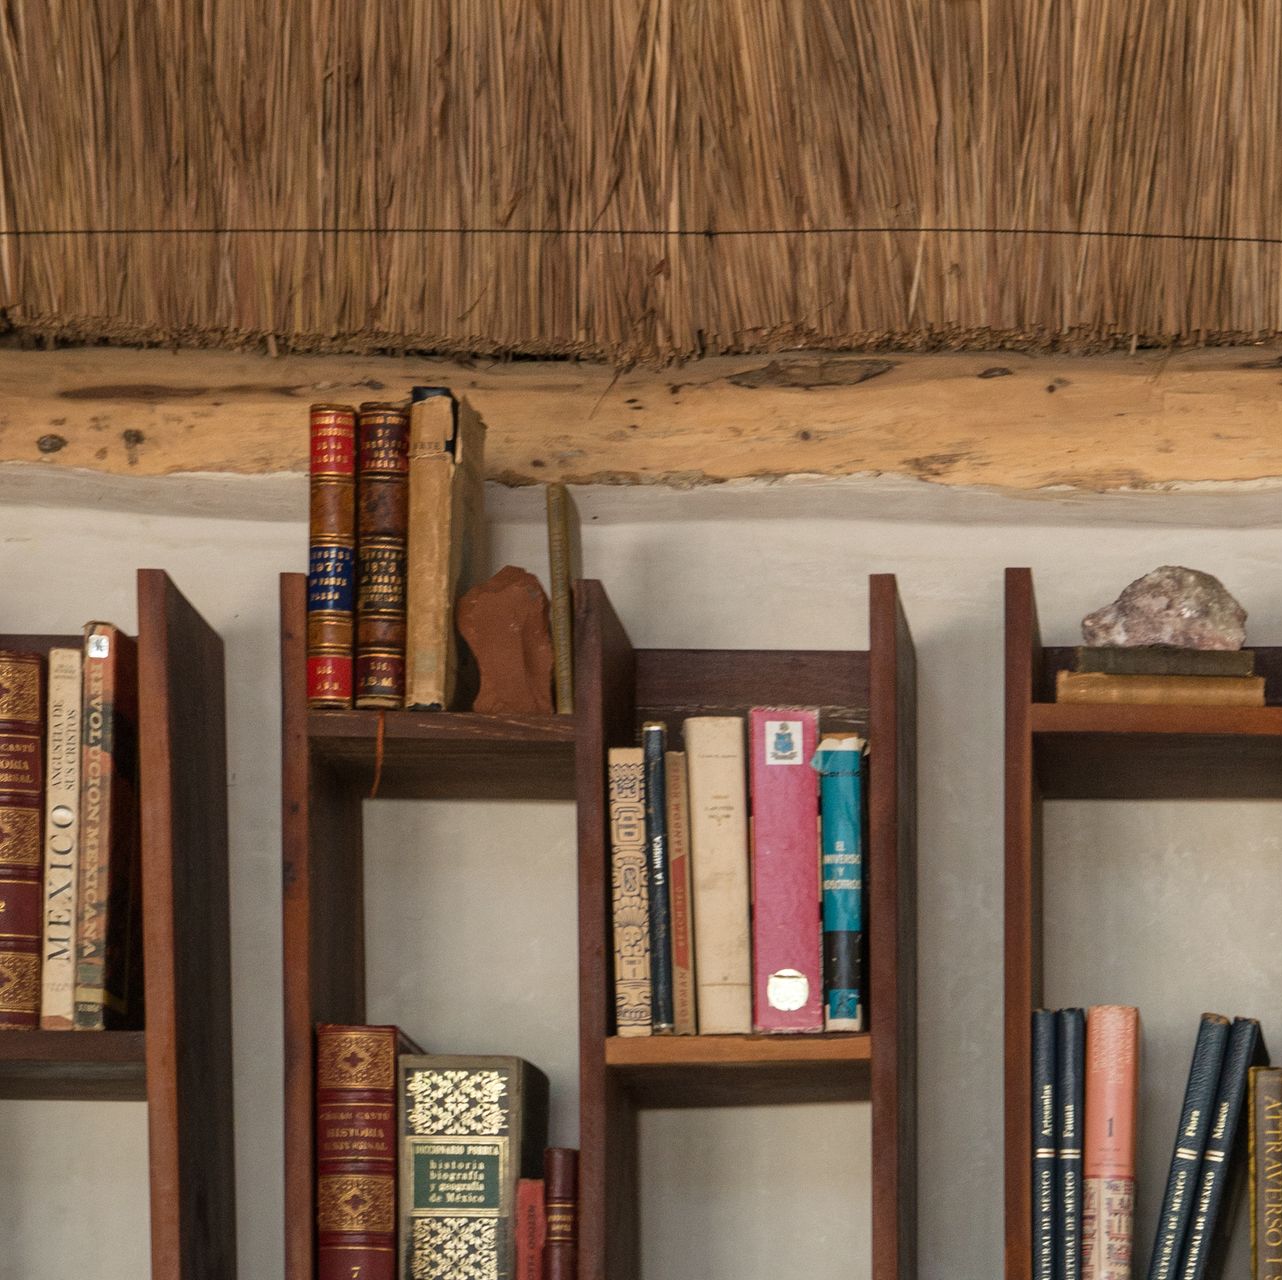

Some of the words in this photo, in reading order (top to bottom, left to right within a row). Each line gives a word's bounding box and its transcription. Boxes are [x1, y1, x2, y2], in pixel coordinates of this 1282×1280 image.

[52, 700, 65, 718] DE
[65, 708, 77, 765] CRISTOS
[87, 663, 104, 823] REVOLUCION
[51, 720, 65, 790] ANGUSTIA
[65, 768, 76, 791] SUS
[652, 835, 663, 869] MUSICA
[48, 804, 75, 961] MEXICO
[653, 871, 665, 885] LA
[83, 825, 100, 957] MEXICANA
[1062, 1104, 1075, 1138] Fauna
[1185, 1109, 1200, 1138] Flora
[1211, 1101, 1230, 1140] Museos
[429, 1159, 485, 1170] historia
[428, 1192, 443, 1203] de
[429, 1183, 437, 1192] y
[1041, 1217, 1052, 1231] DE
[1064, 1217, 1076, 1231] DE
[1168, 1215, 1179, 1231] DE
[1195, 1215, 1206, 1231] DE
[351, 1266, 362, 1279] 7
